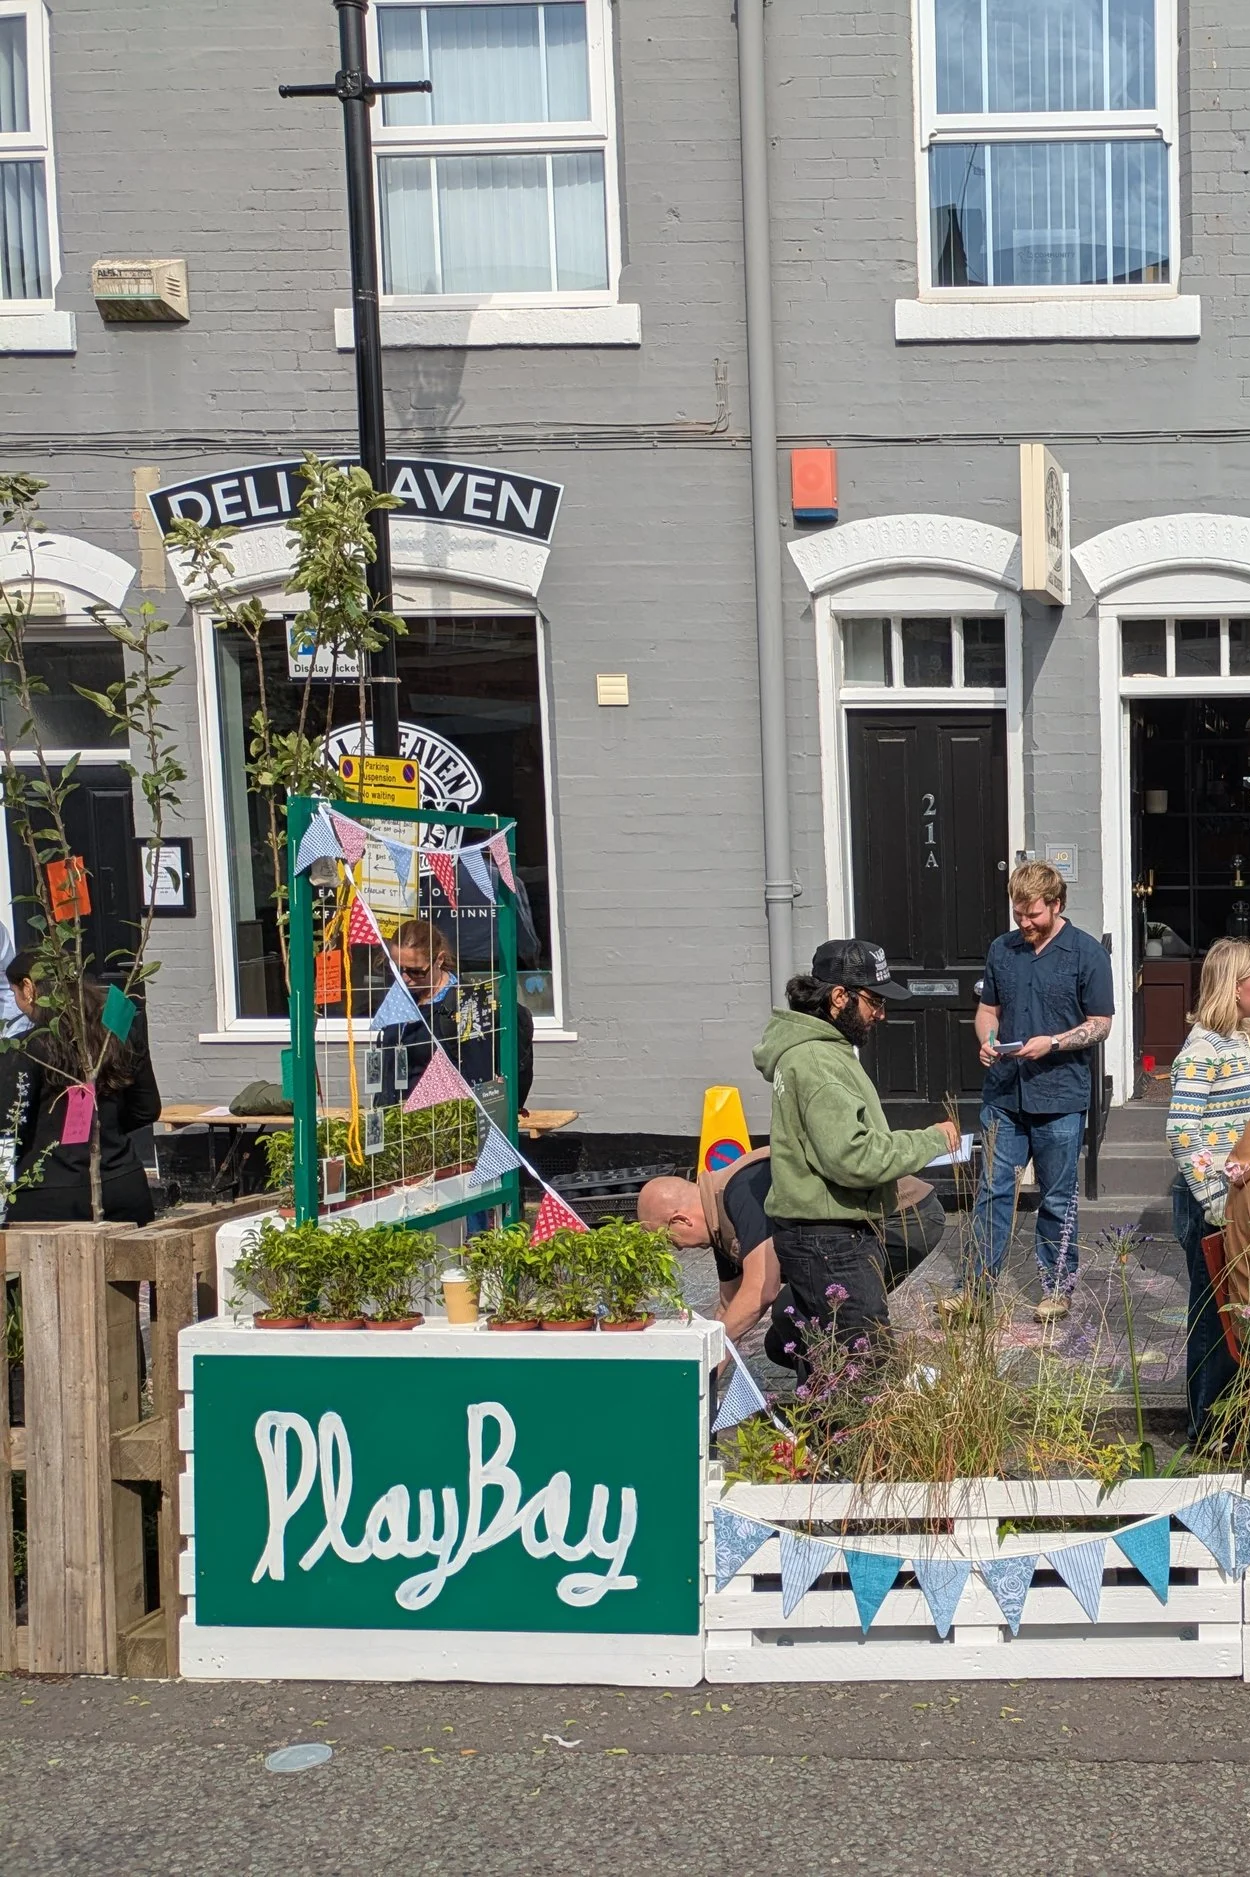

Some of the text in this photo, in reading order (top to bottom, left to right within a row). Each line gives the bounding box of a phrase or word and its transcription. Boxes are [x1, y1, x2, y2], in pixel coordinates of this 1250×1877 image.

[167, 466, 542, 529] DELI AVEN
[365, 761, 390, 773] Parking
[362, 773, 397, 783] uspension
[371, 791, 396, 801] waiting
[450, 909, 498, 918] DINNE
